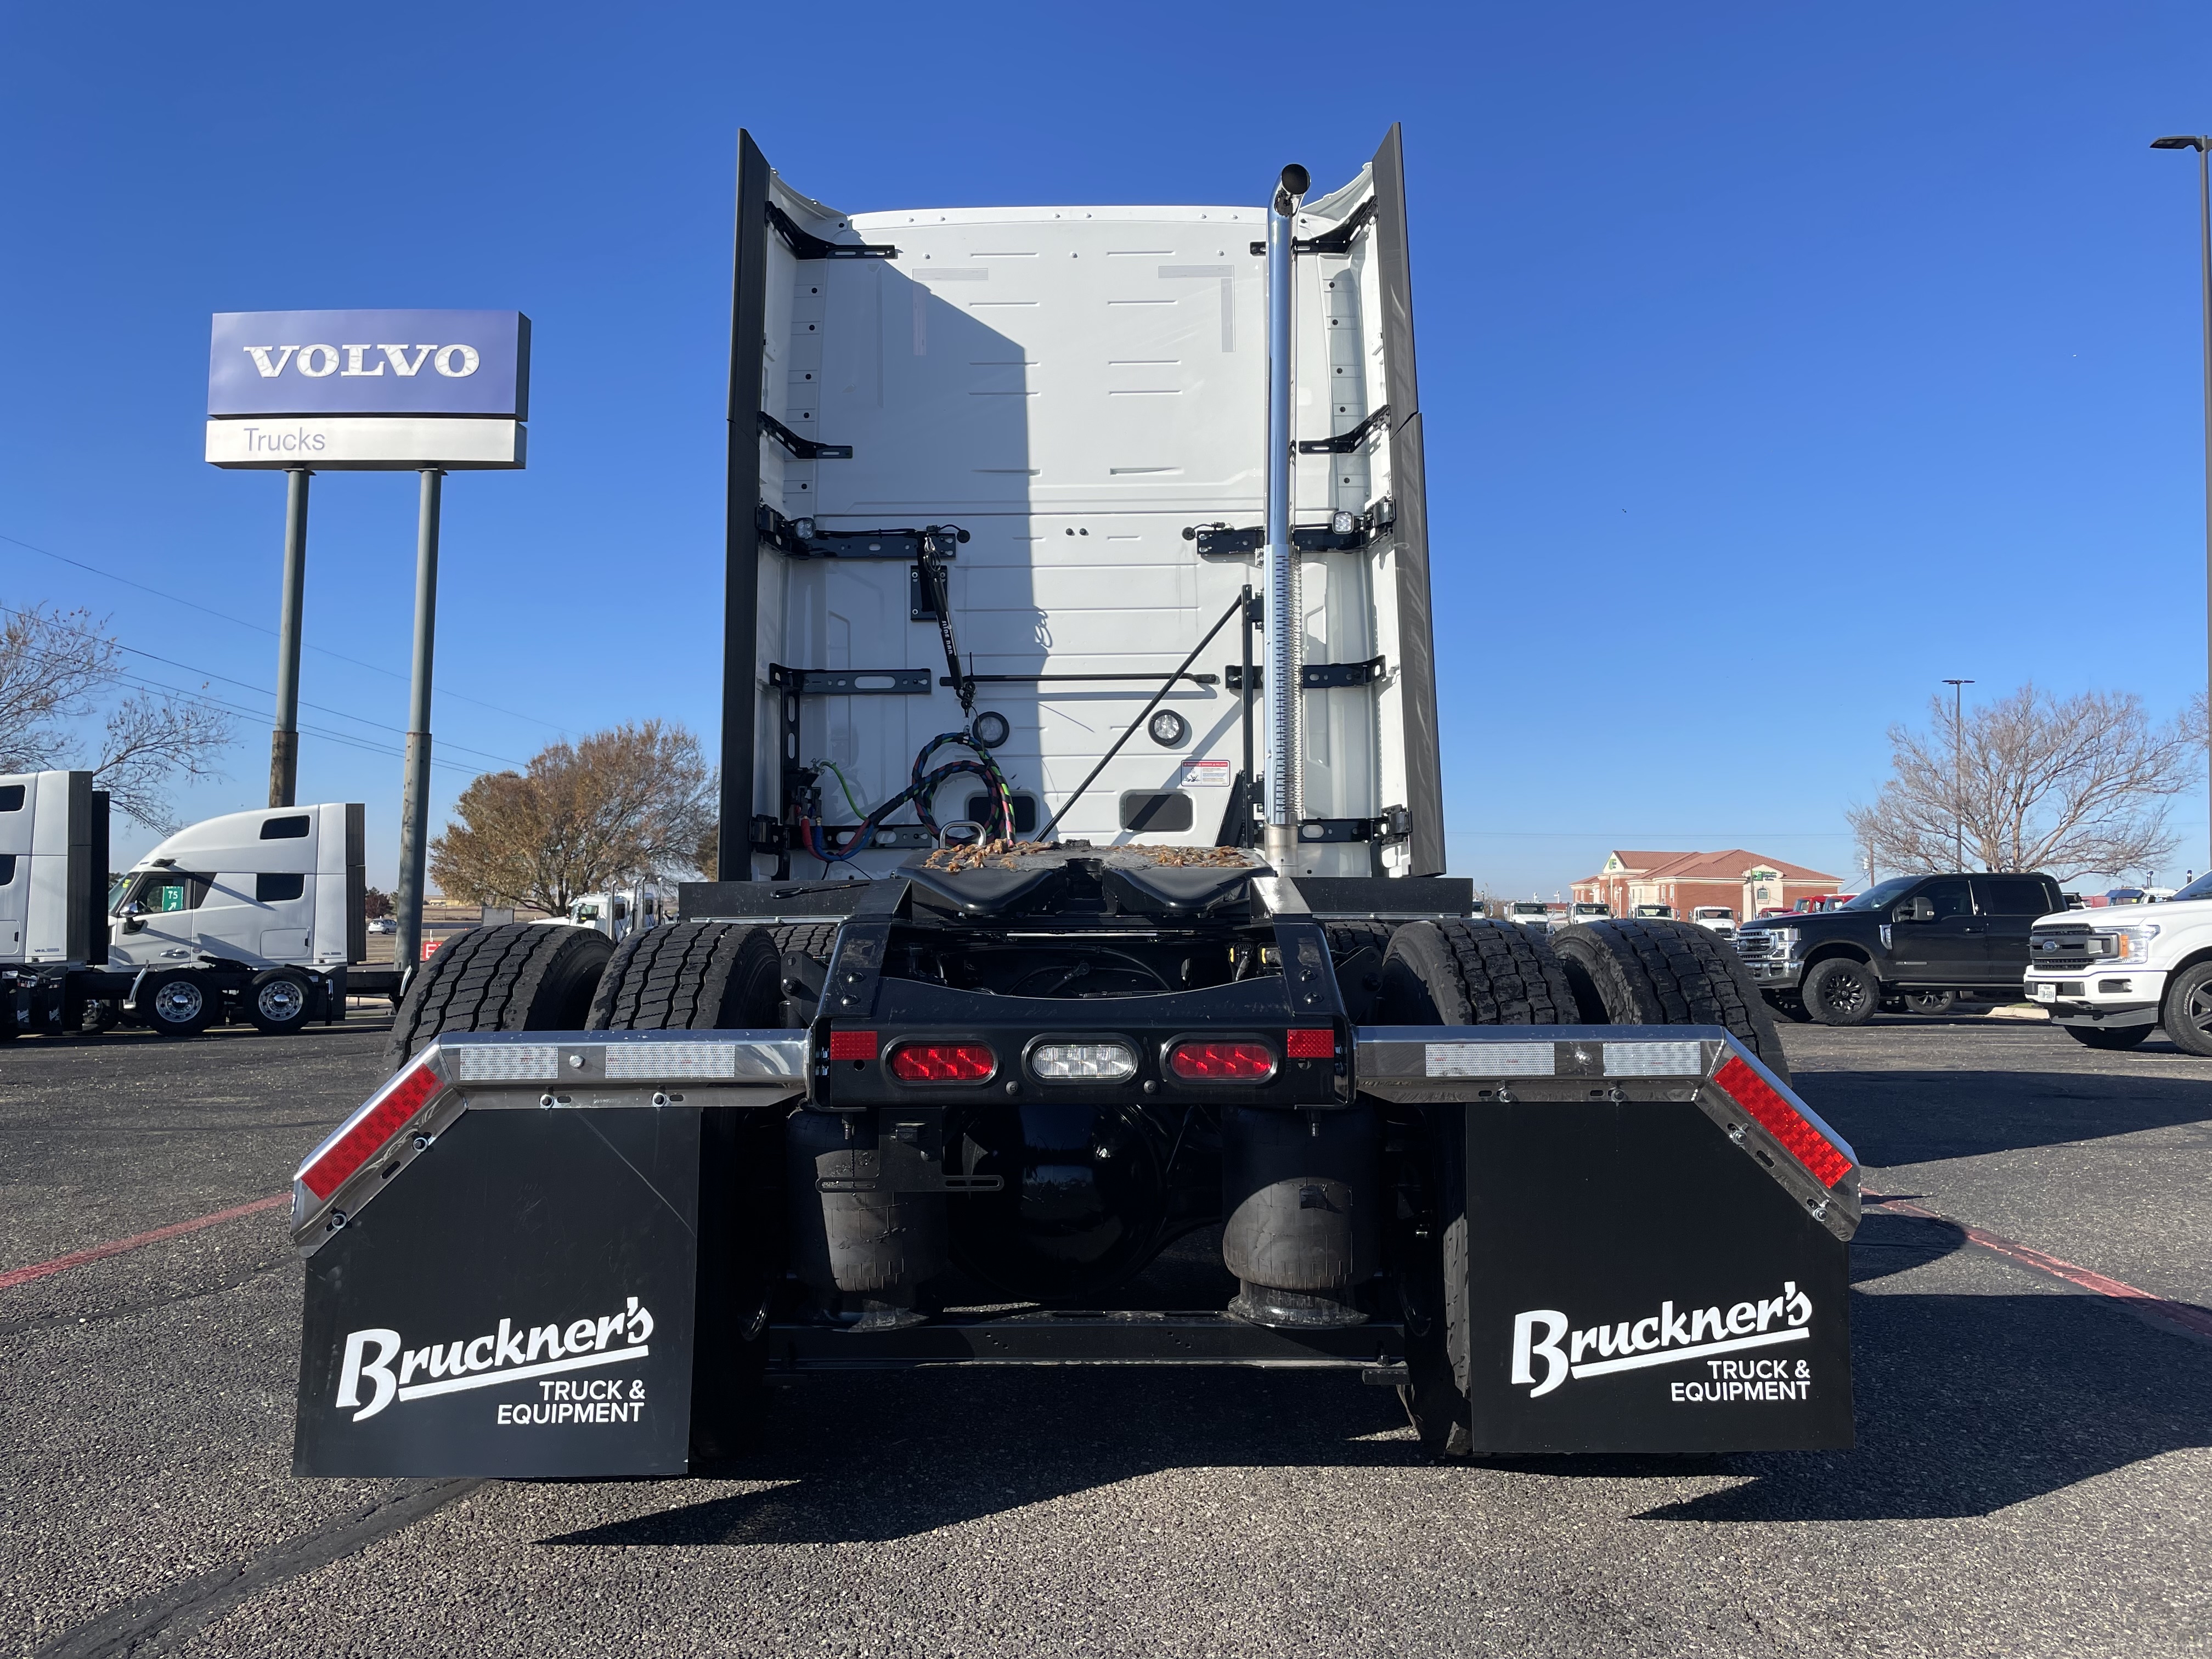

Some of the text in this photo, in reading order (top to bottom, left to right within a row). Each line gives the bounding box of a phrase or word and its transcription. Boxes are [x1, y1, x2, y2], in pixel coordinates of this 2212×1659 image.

[243, 343, 479, 378] VOLVO
[243, 427, 325, 451] Trucks
[168, 890, 178, 899] 75
[2183, 983, 2196, 1015] COOPER
[1511, 1281, 1813, 1398] Bruckner's
[335, 1296, 654, 1423] Bruckner's
[1707, 1359, 1811, 1379] TRUCK &
[539, 1379, 646, 1401] TRUCK &
[1671, 1380, 1810, 1402] EQUIPMENT
[497, 1402, 645, 1425] EQUIPMENT
